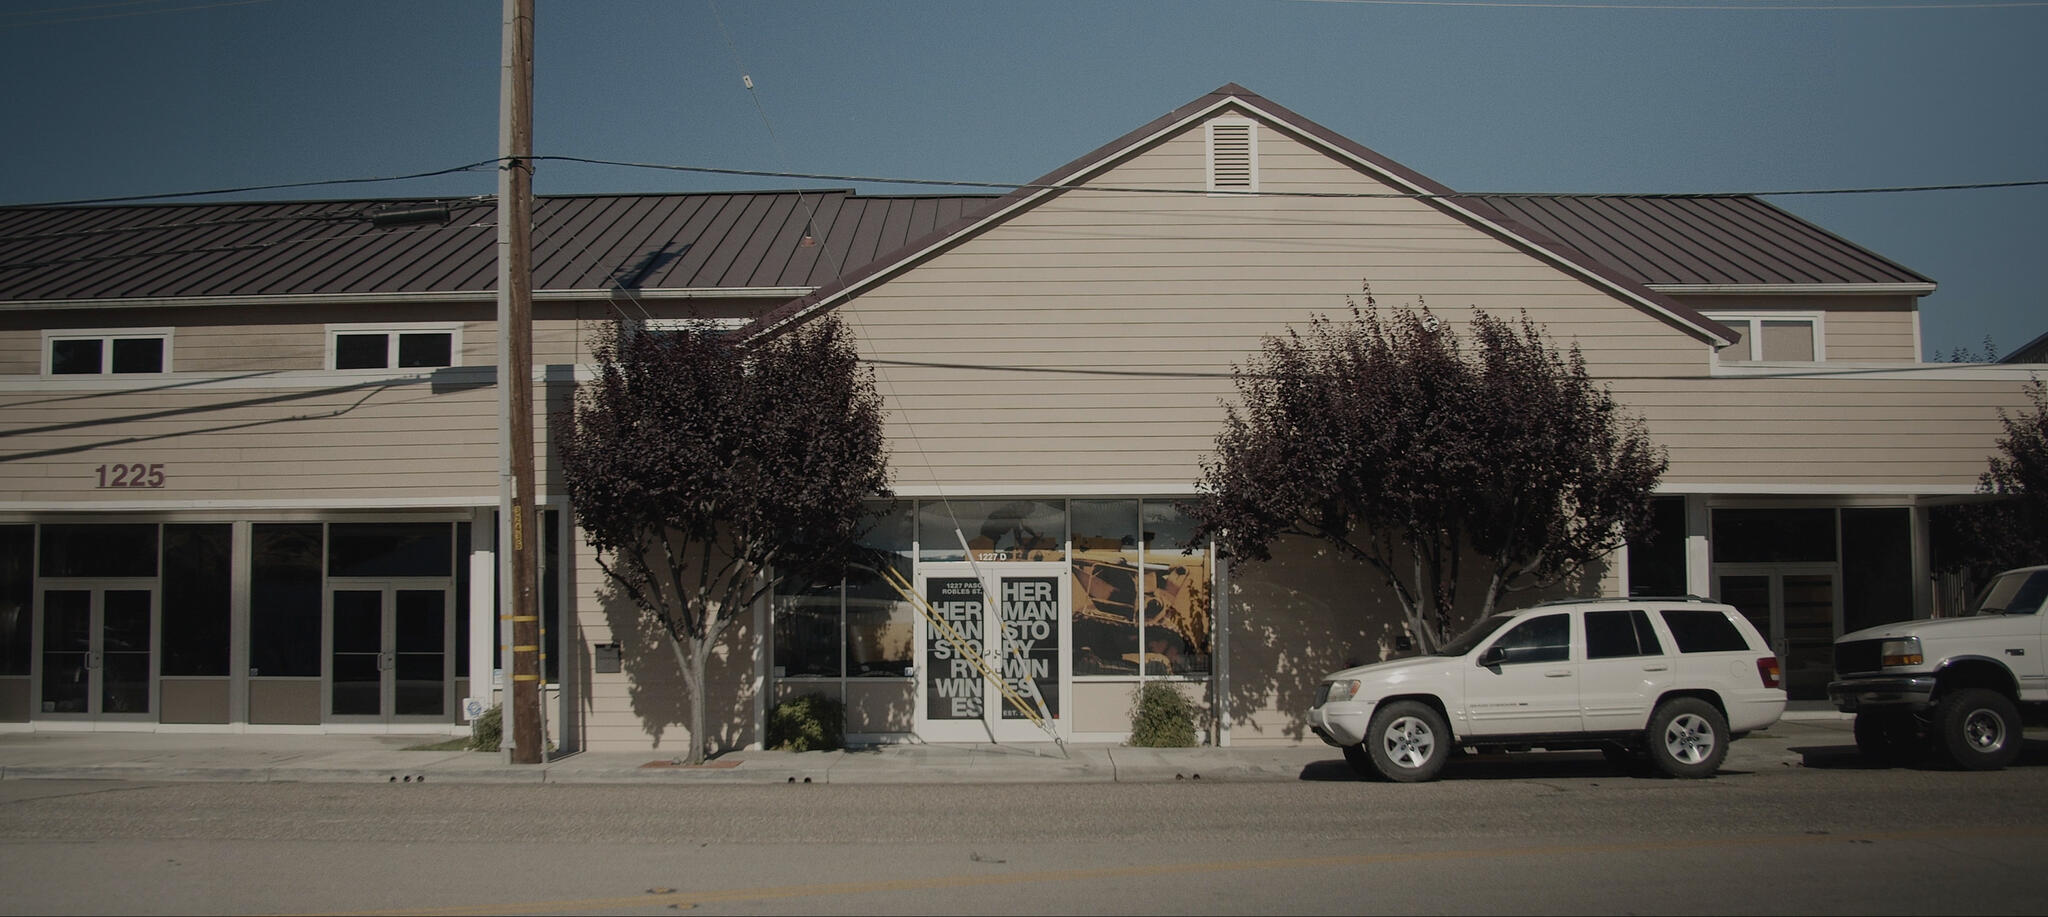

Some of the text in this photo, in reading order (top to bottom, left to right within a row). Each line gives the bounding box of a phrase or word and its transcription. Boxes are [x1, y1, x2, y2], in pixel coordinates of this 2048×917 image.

[95, 463, 165, 488] 1225
[978, 553, 1007, 561] 1227 D
[1002, 582, 1052, 601] HER
[932, 601, 983, 621] HER
[1002, 601, 1057, 621] MAN
[927, 620, 983, 640] MAN
[1002, 620, 1050, 640] STO
[934, 639, 983, 660] STO
[950, 658, 984, 678] RY
[934, 677, 983, 698] WIN
[951, 697, 983, 717] ES
